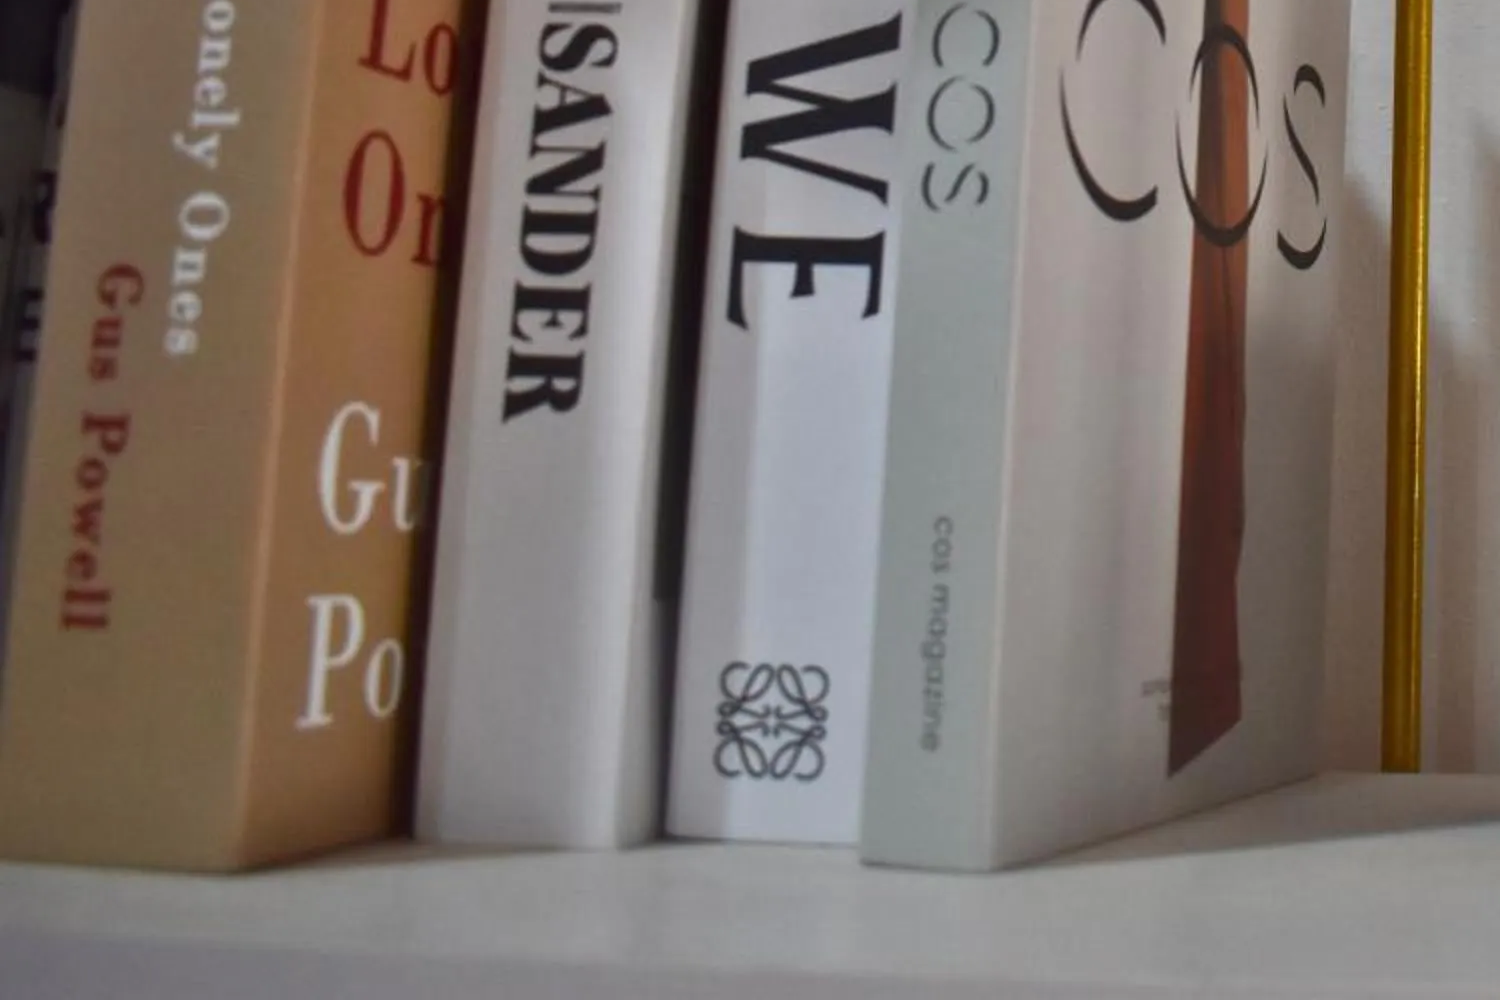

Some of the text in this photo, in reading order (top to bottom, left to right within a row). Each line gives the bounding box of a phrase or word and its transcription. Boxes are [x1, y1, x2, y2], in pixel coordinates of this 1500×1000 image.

[921, 2, 1000, 212] COS
[163, 191, 230, 357] Ones
[61, 263, 144, 633] Gus Powell
[919, 515, 953, 753] cos magazine
